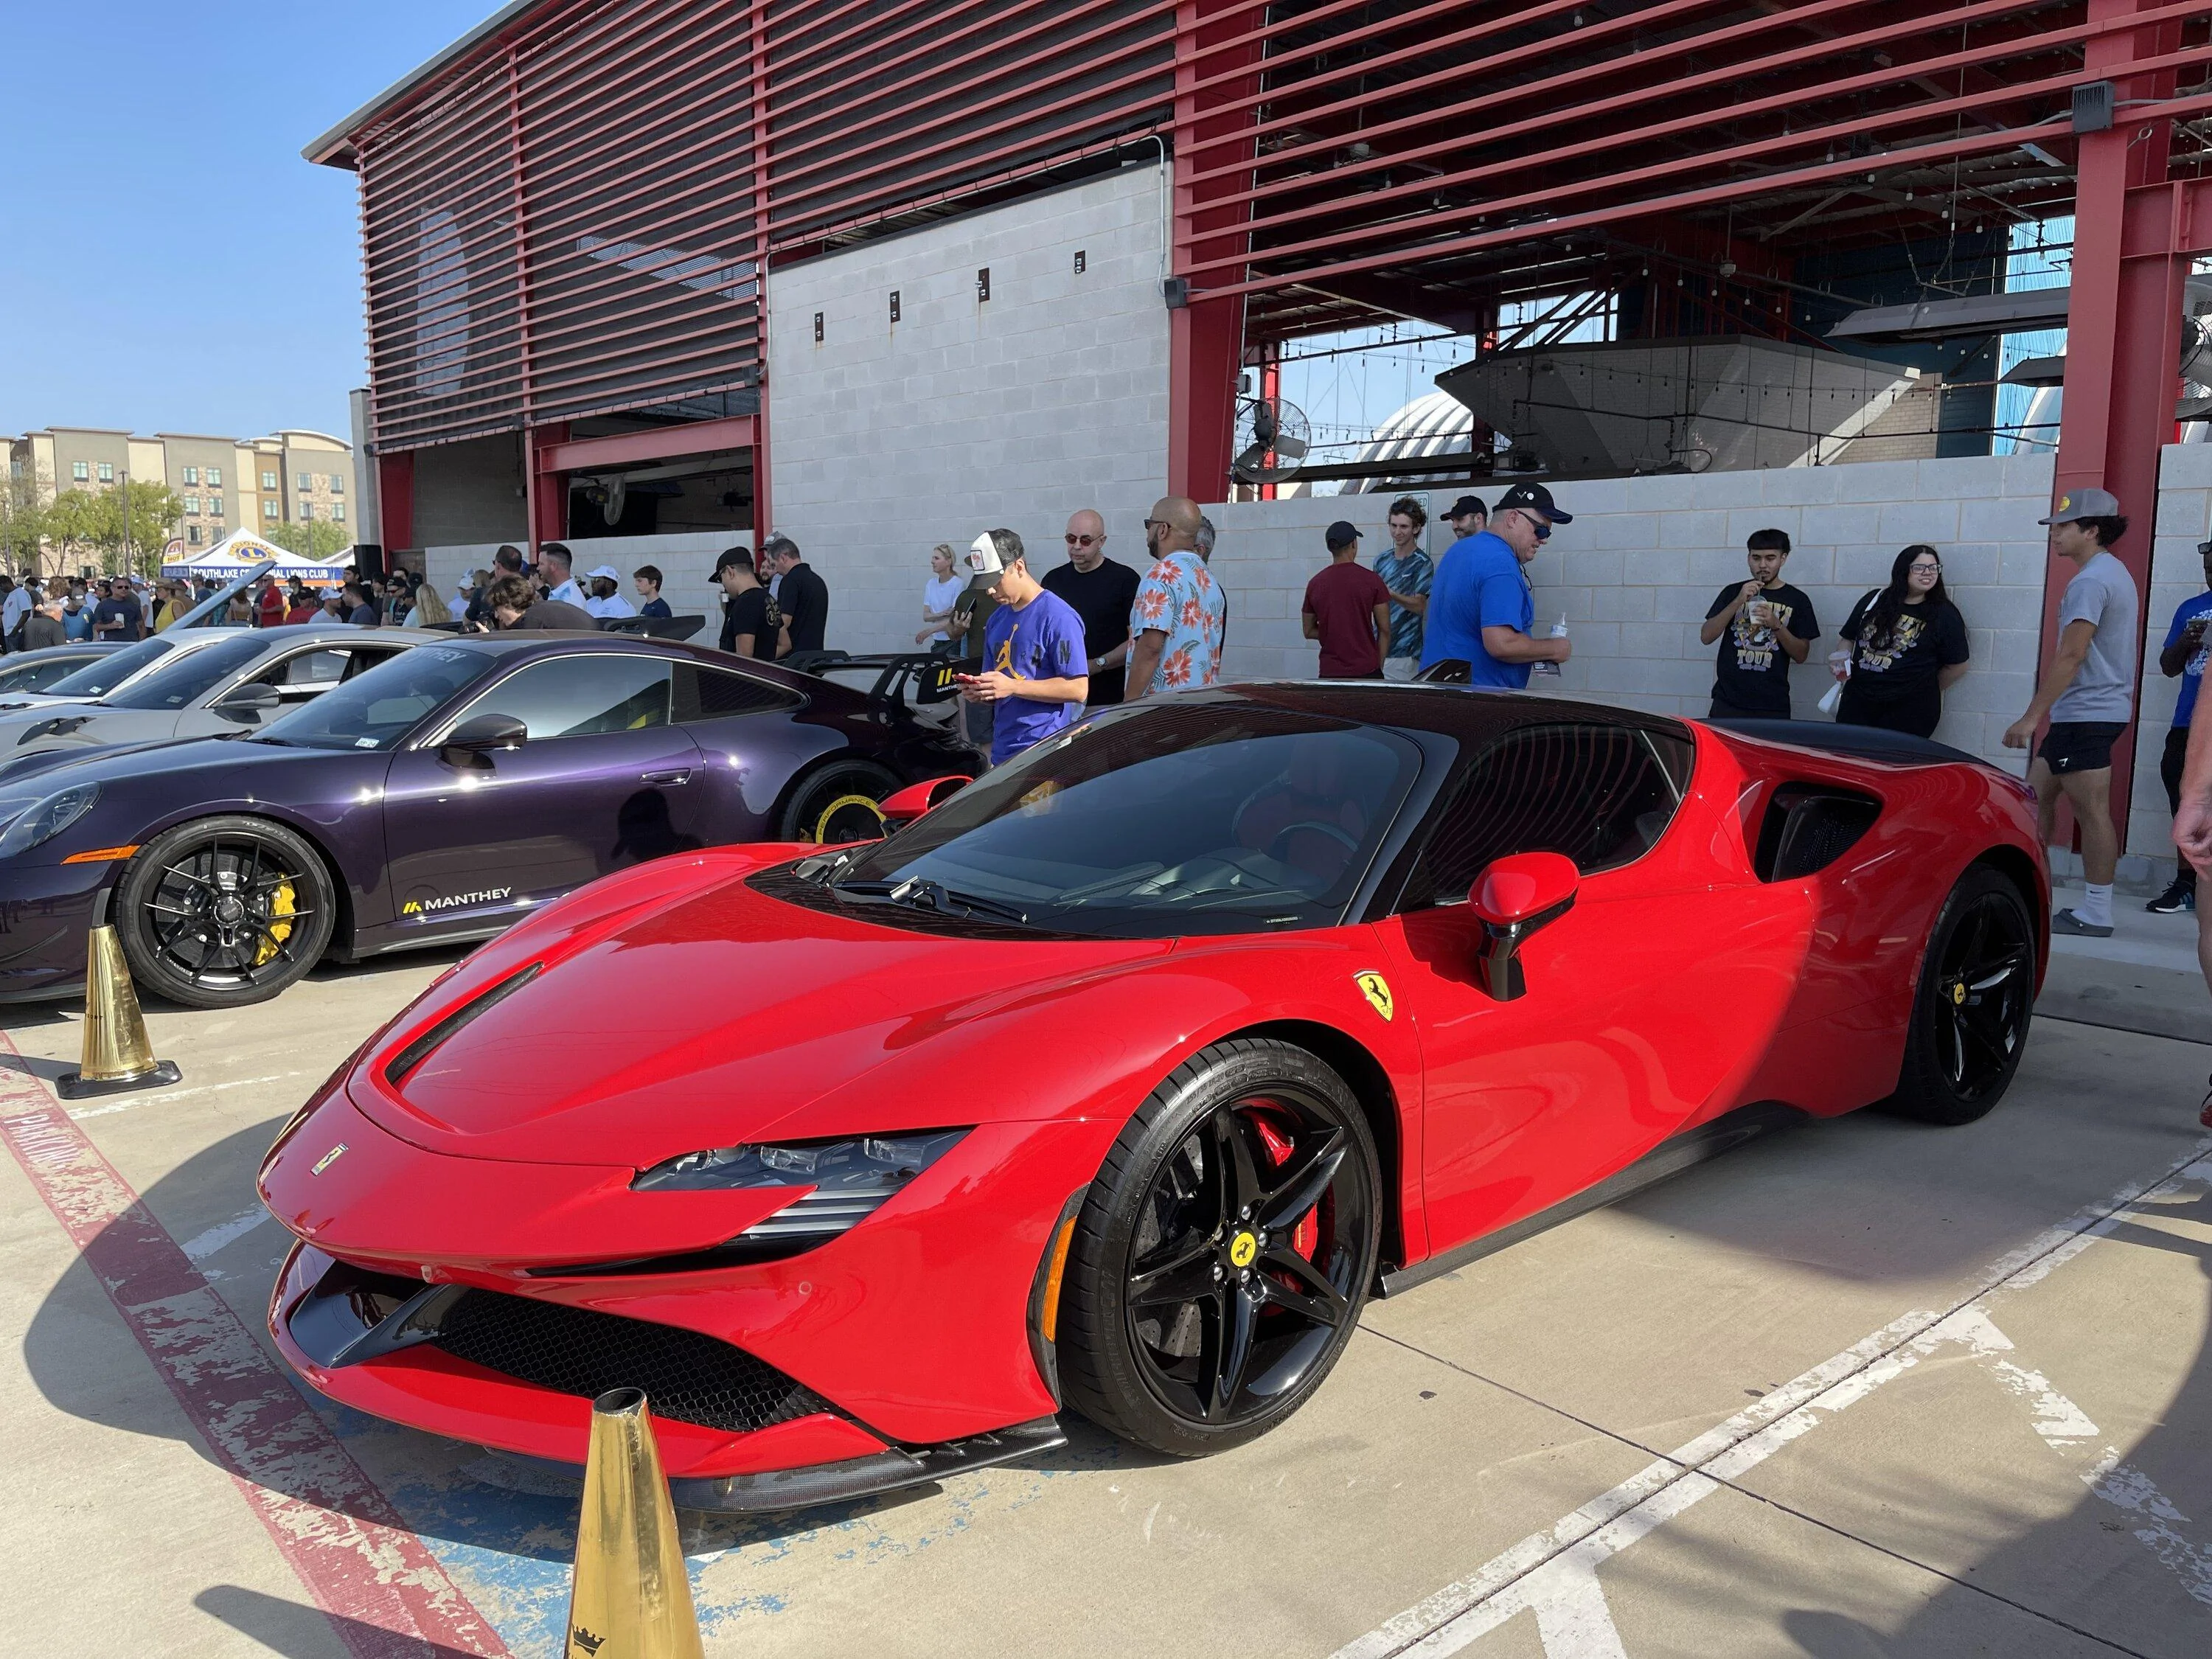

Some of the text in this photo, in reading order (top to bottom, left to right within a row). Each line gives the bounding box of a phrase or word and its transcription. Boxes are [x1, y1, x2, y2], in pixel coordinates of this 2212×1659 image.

[309, 568, 328, 579] CLUB
[1737, 650, 1773, 668] TOUR
[425, 886, 512, 911] MANTHEY
